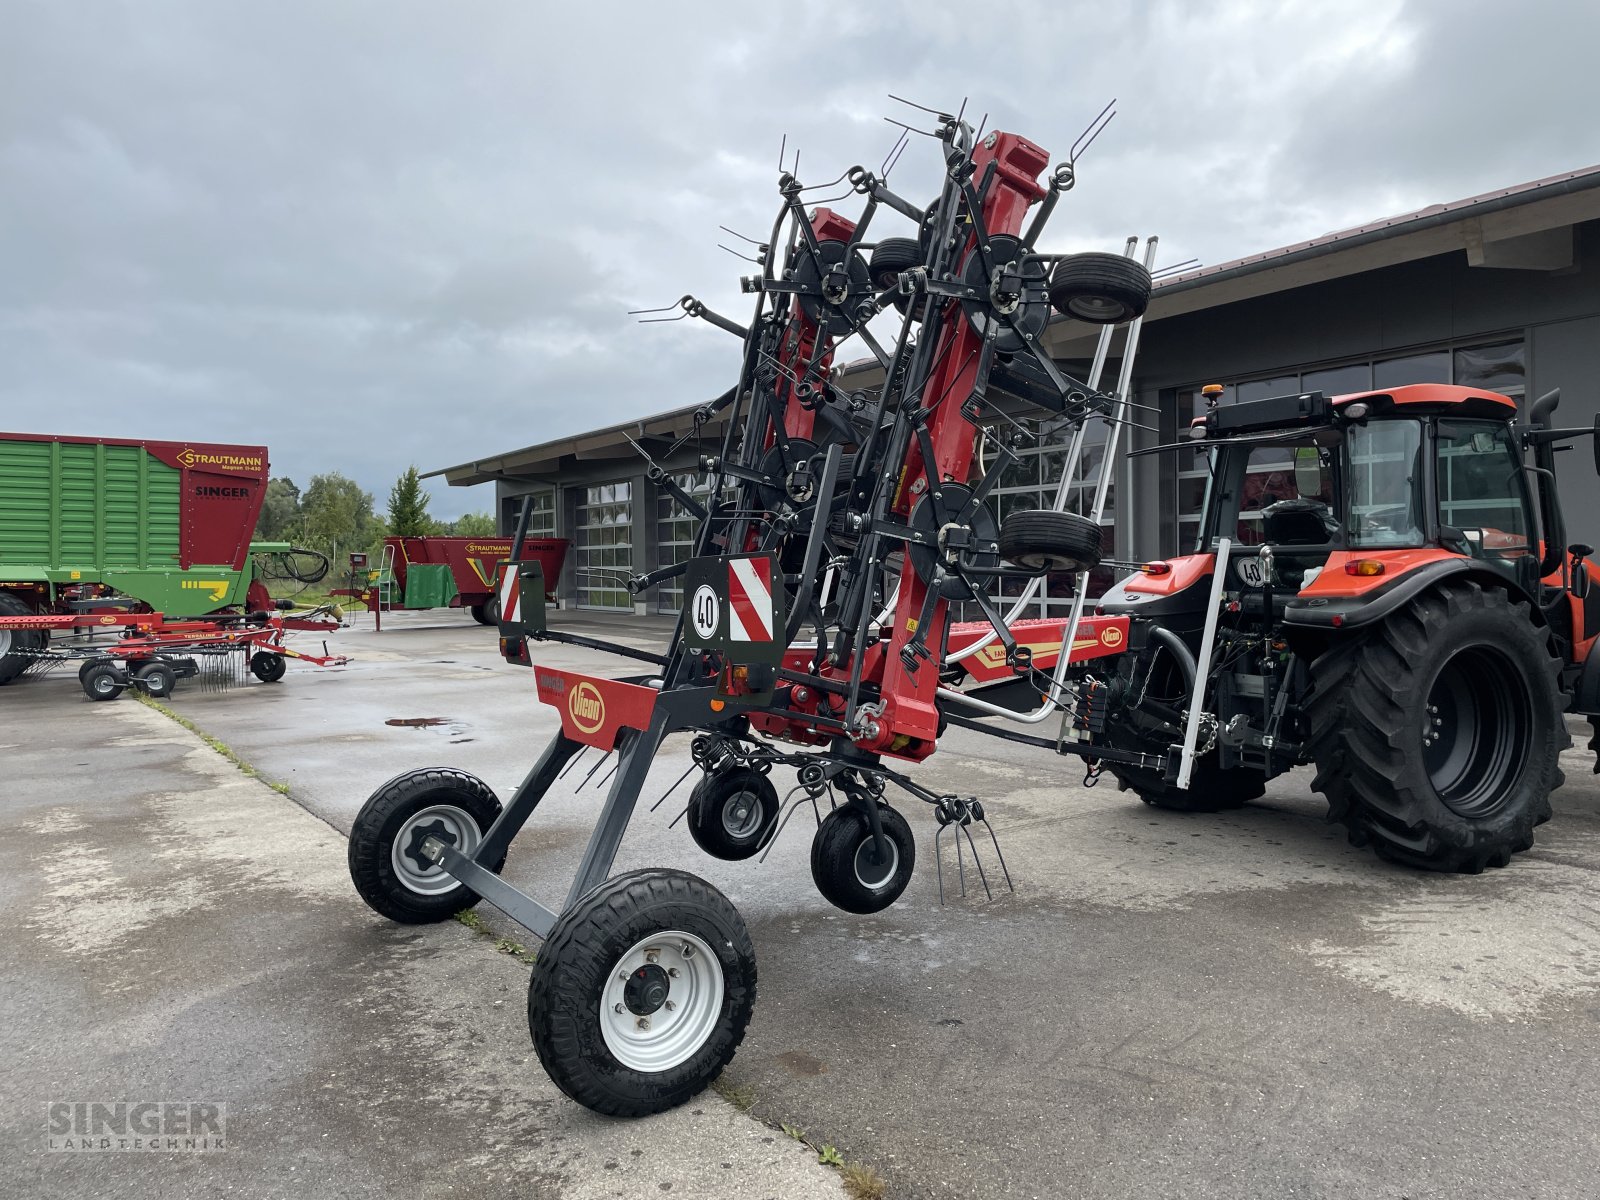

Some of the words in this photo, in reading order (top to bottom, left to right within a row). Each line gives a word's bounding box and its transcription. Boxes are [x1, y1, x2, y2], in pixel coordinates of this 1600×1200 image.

[185, 453, 262, 466] STRAUTMANN
[195, 486, 249, 497] SINGER
[1243, 564, 1262, 582] 40
[697, 595, 714, 629] 40
[1059, 624, 1096, 637] SGER
[994, 650, 1008, 658] FAN
